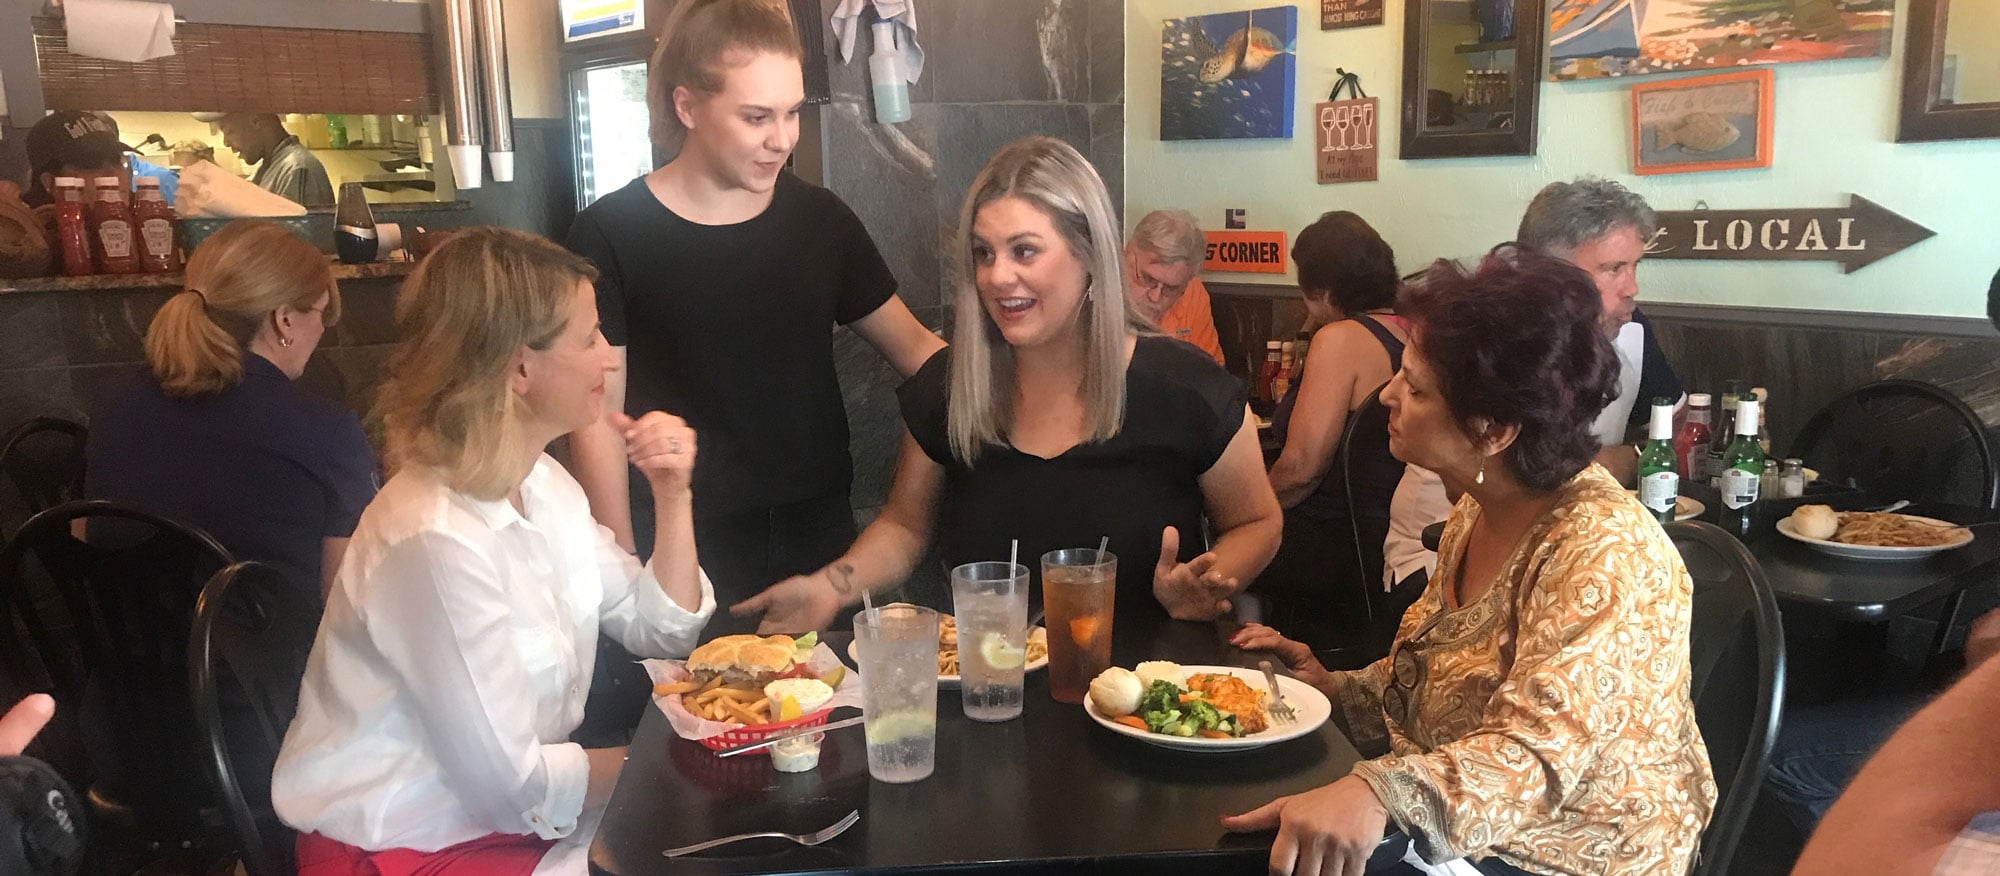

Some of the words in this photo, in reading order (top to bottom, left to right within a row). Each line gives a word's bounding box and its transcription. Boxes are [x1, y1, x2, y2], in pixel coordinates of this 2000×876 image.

[1323, 3, 1347, 12] THAN
[1692, 218, 1866, 251] LOCAL
[1219, 242, 1279, 263] CORNER
